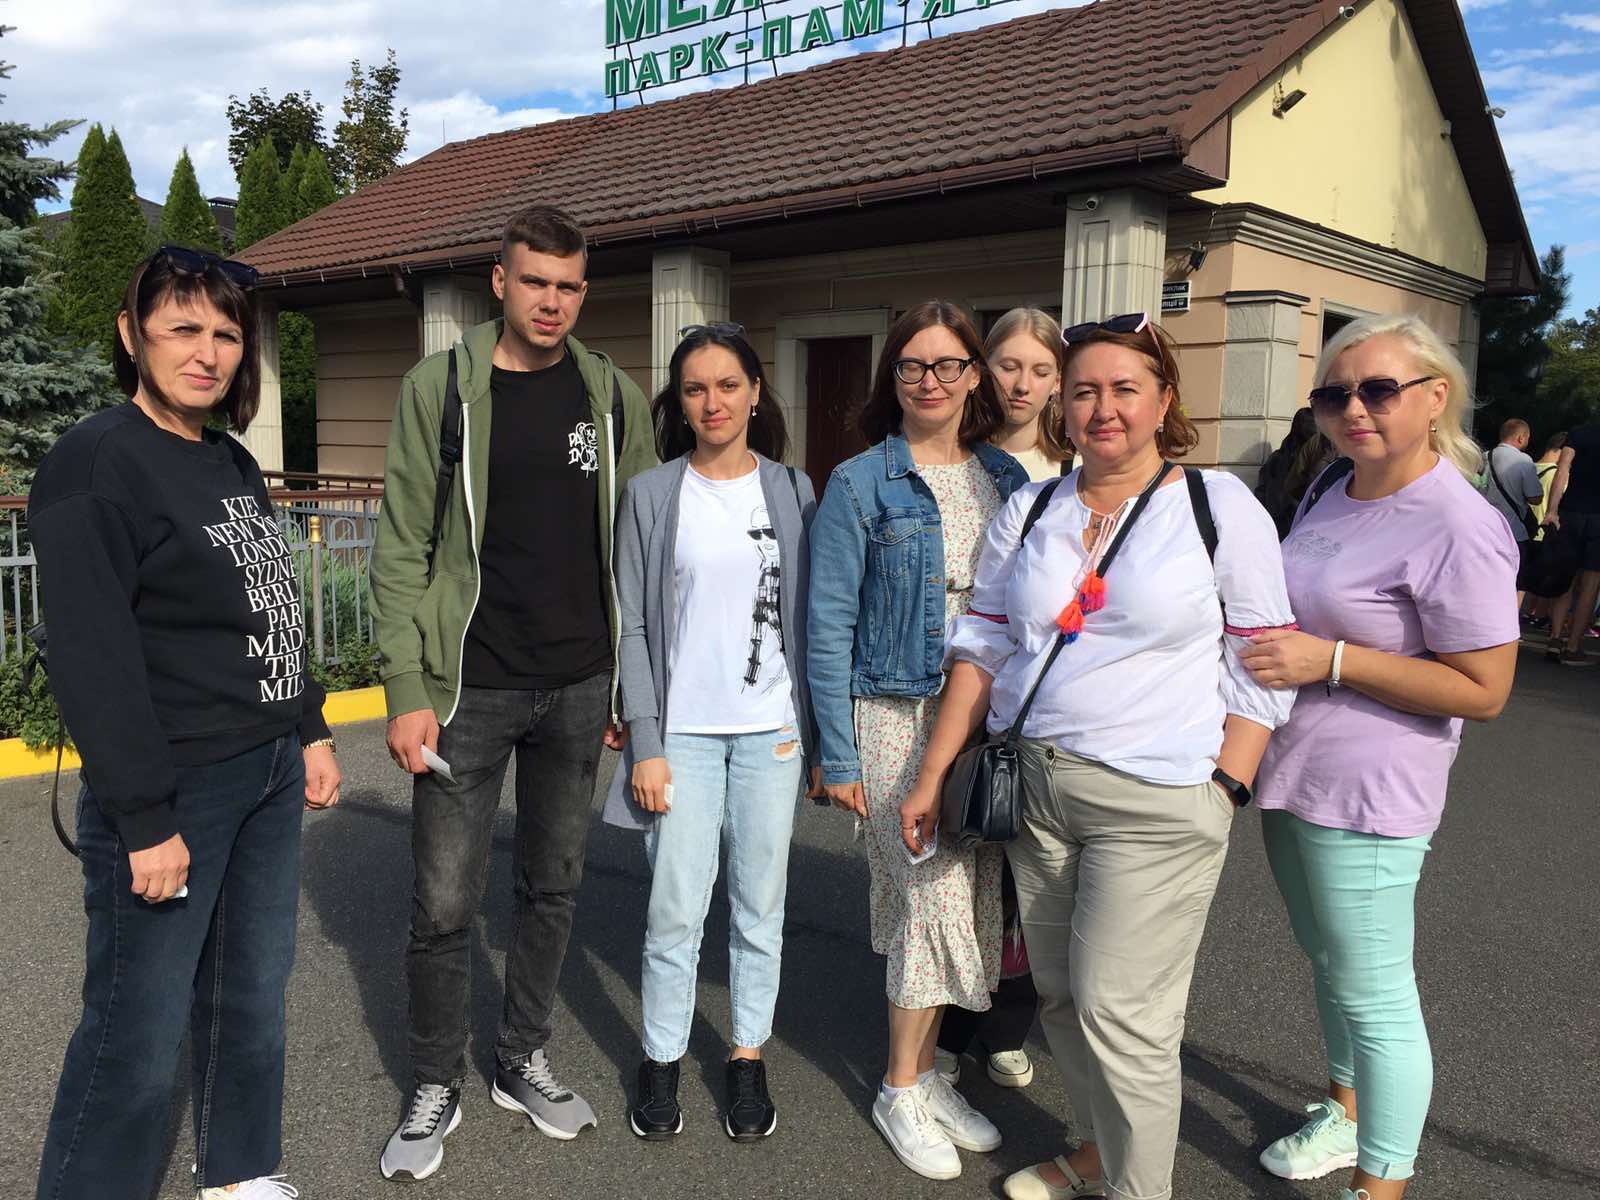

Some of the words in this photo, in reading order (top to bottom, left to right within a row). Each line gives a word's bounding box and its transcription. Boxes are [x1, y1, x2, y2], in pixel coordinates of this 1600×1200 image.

[202, 519, 256, 547] NEW
[246, 627, 303, 657] MAD
[258, 674, 304, 703] MIL
